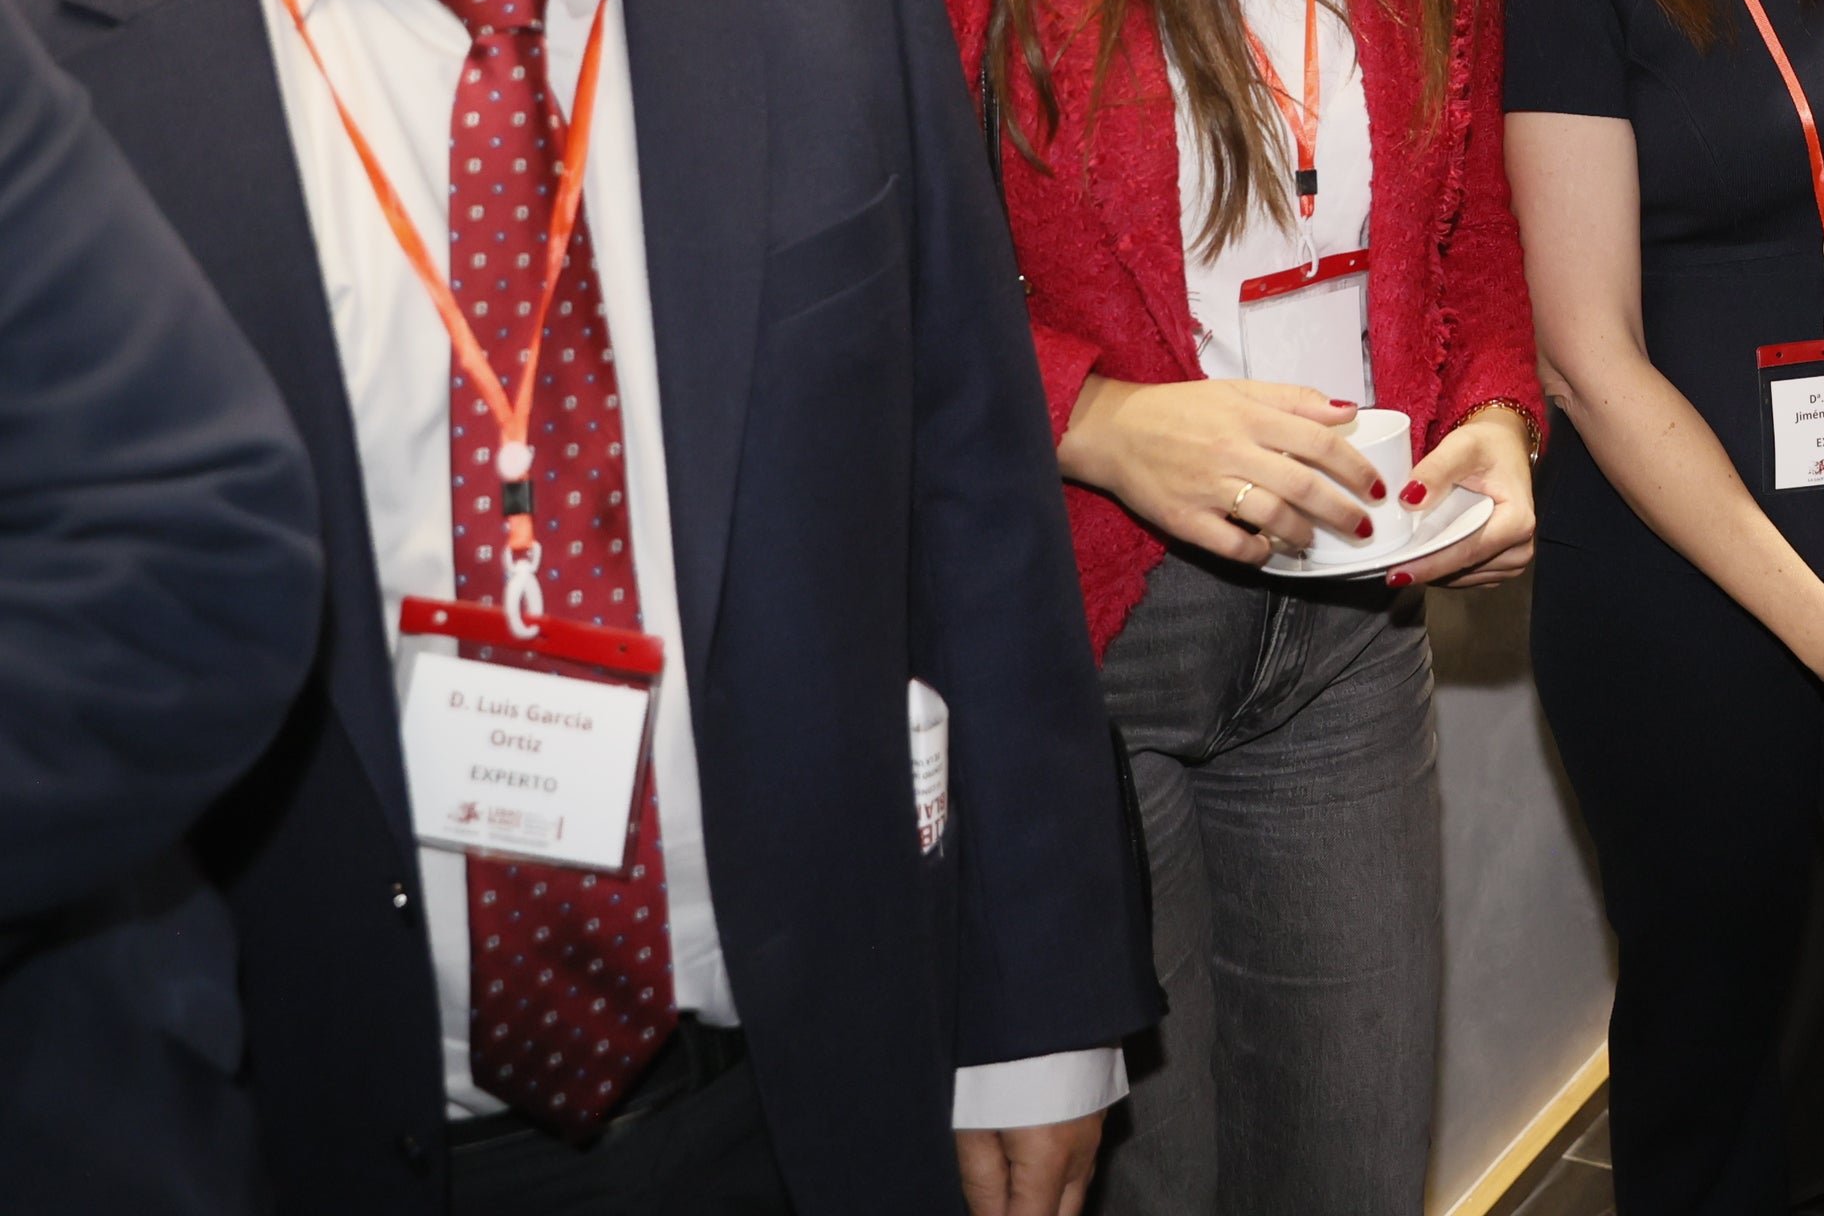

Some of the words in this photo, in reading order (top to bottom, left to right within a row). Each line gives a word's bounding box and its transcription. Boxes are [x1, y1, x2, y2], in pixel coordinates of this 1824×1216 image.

[448, 691, 469, 710] D.
[477, 697, 519, 720] Luis
[526, 704, 594, 732] García
[490, 729, 543, 754] Ortiz
[470, 764, 559, 794] EXPERTO
